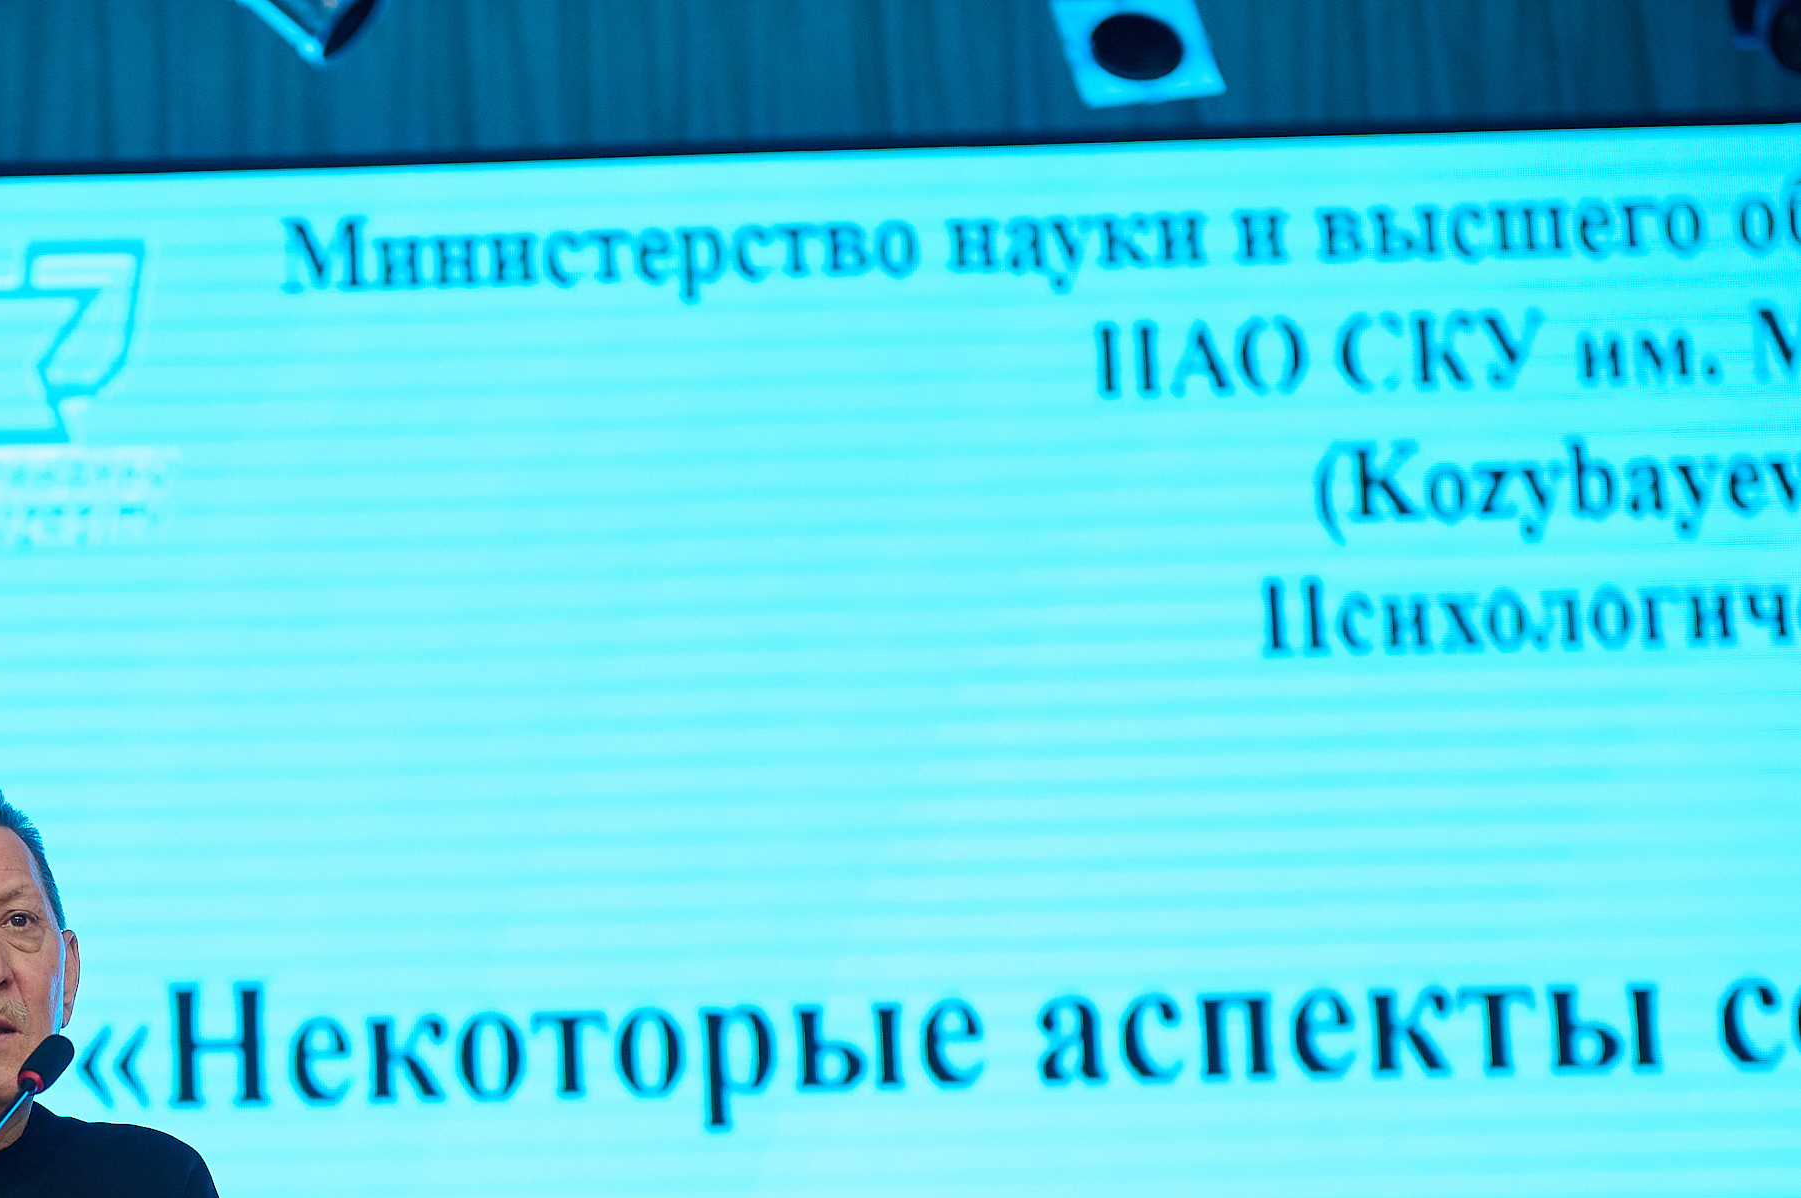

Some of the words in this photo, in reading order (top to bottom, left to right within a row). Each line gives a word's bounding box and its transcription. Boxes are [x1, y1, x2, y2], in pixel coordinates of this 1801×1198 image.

[282, 217, 919, 302] Министерство
[950, 213, 1206, 292] науки
[1235, 210, 1286, 263] и
[1318, 196, 1705, 262] высшего
[1336, 310, 1542, 390] СКУ
[1578, 331, 1721, 386] им.
[1315, 437, 1801, 541] (Kozybayev
[1264, 577, 1801, 655] Психологич
[80, 979, 984, 1131] «Некоторые
[1038, 984, 1662, 1085] аспекты
[1719, 978, 1801, 1071] с
